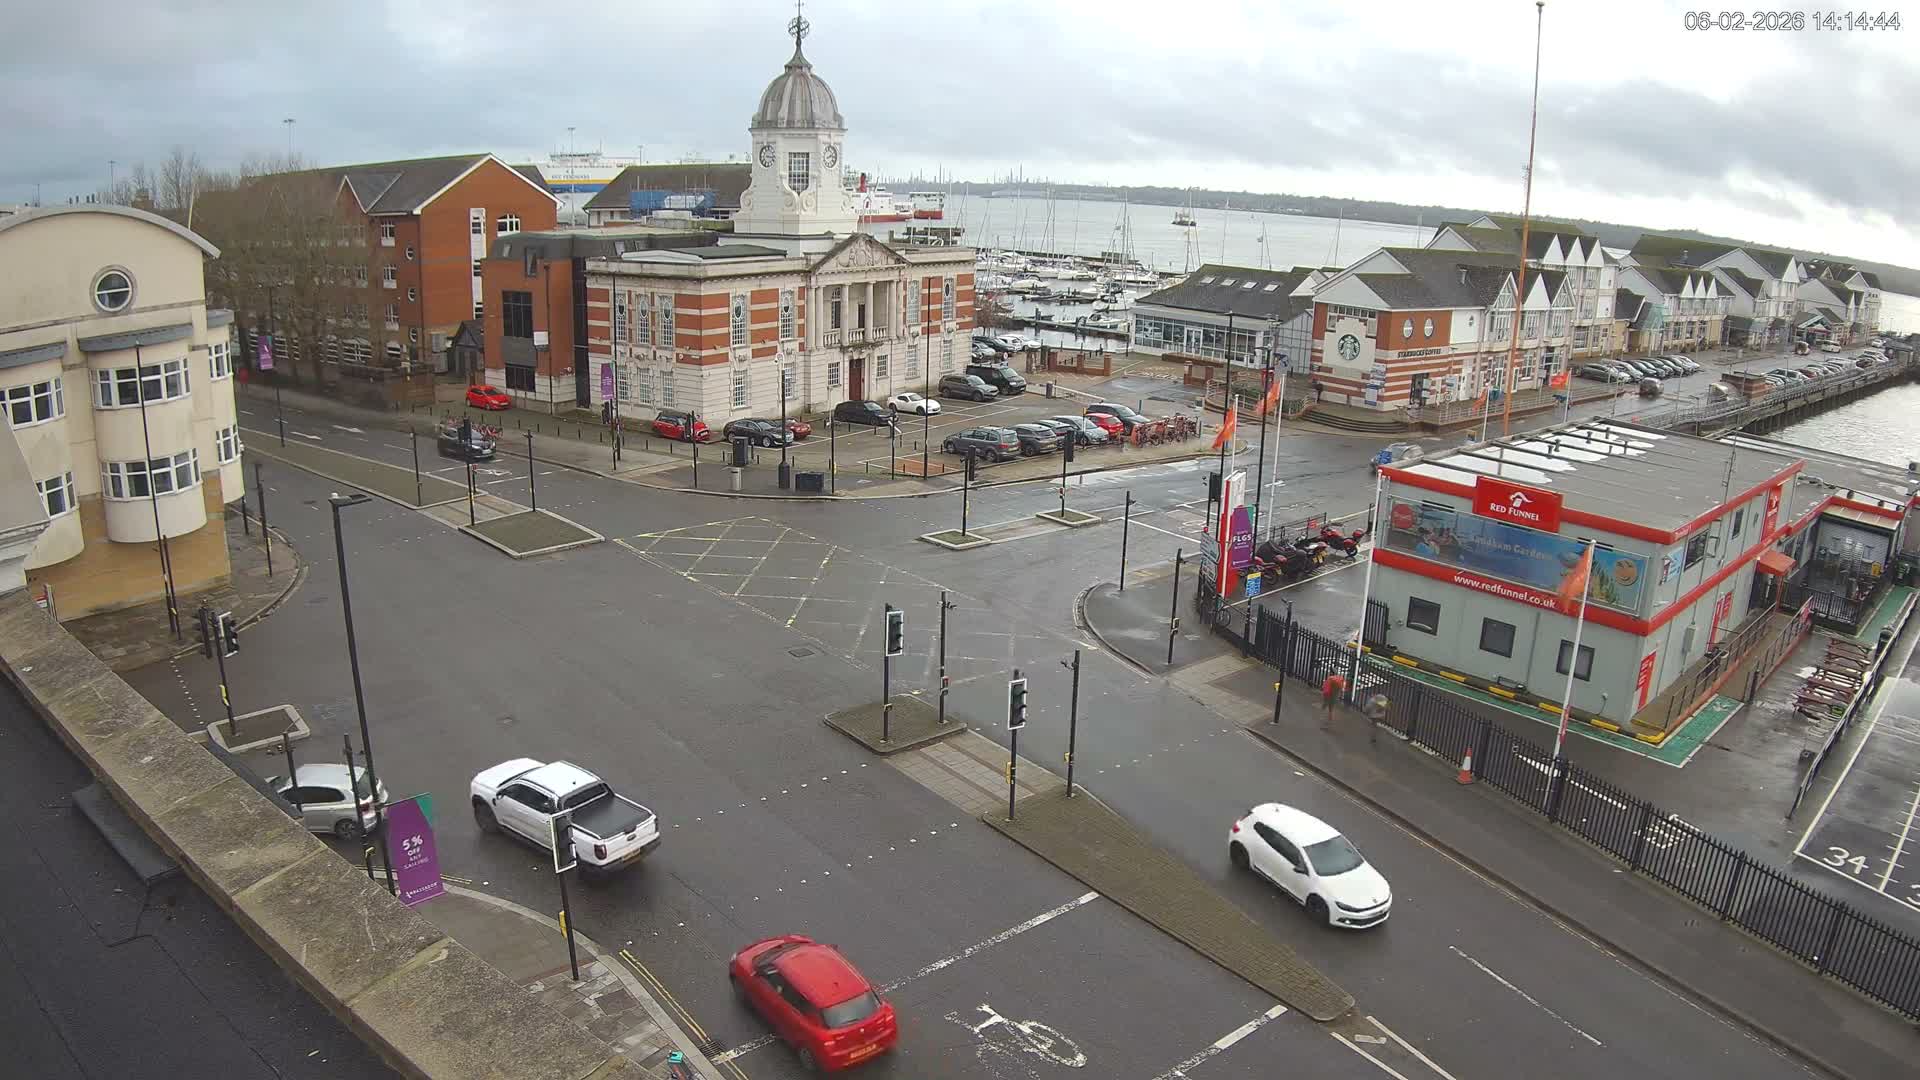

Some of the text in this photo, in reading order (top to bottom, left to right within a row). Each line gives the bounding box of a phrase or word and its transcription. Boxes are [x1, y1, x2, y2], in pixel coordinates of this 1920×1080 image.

[1489, 502, 1540, 521] RED FUNNEL
[1454, 575, 1556, 609] www.redfunnel.co.uk
[407, 847, 421, 856] OFF
[1824, 845, 1869, 875] 34
